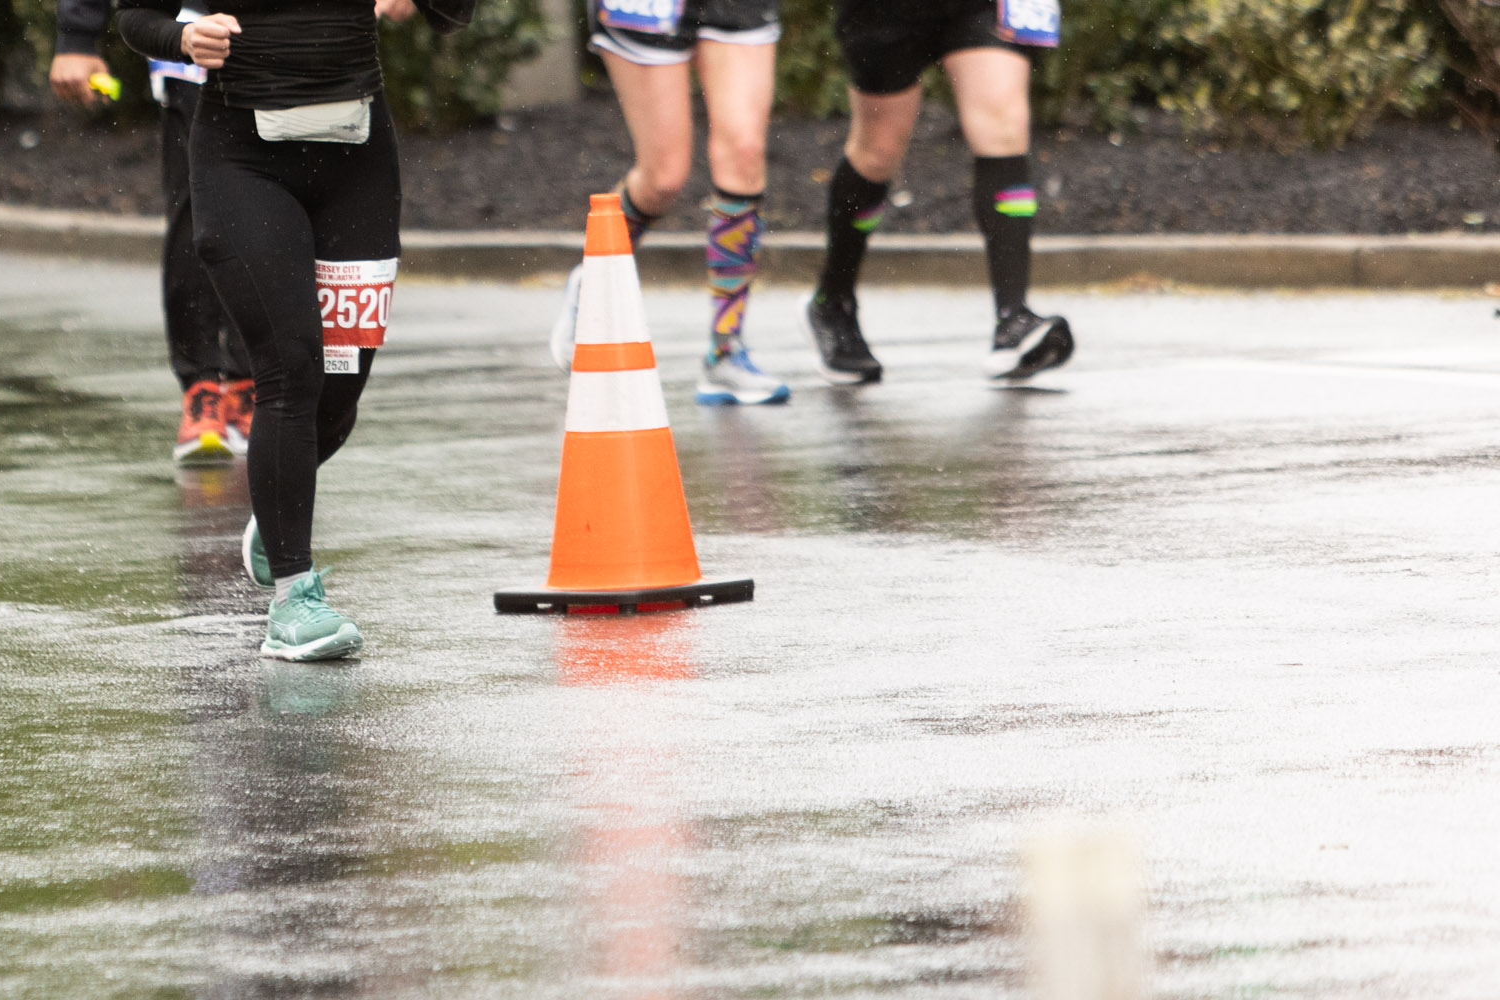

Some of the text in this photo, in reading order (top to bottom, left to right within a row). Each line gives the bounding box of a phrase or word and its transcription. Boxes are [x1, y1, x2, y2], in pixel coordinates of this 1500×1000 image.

[342, 265, 361, 273] CITY
[317, 286, 392, 329] 2520
[325, 360, 349, 371] 2520
